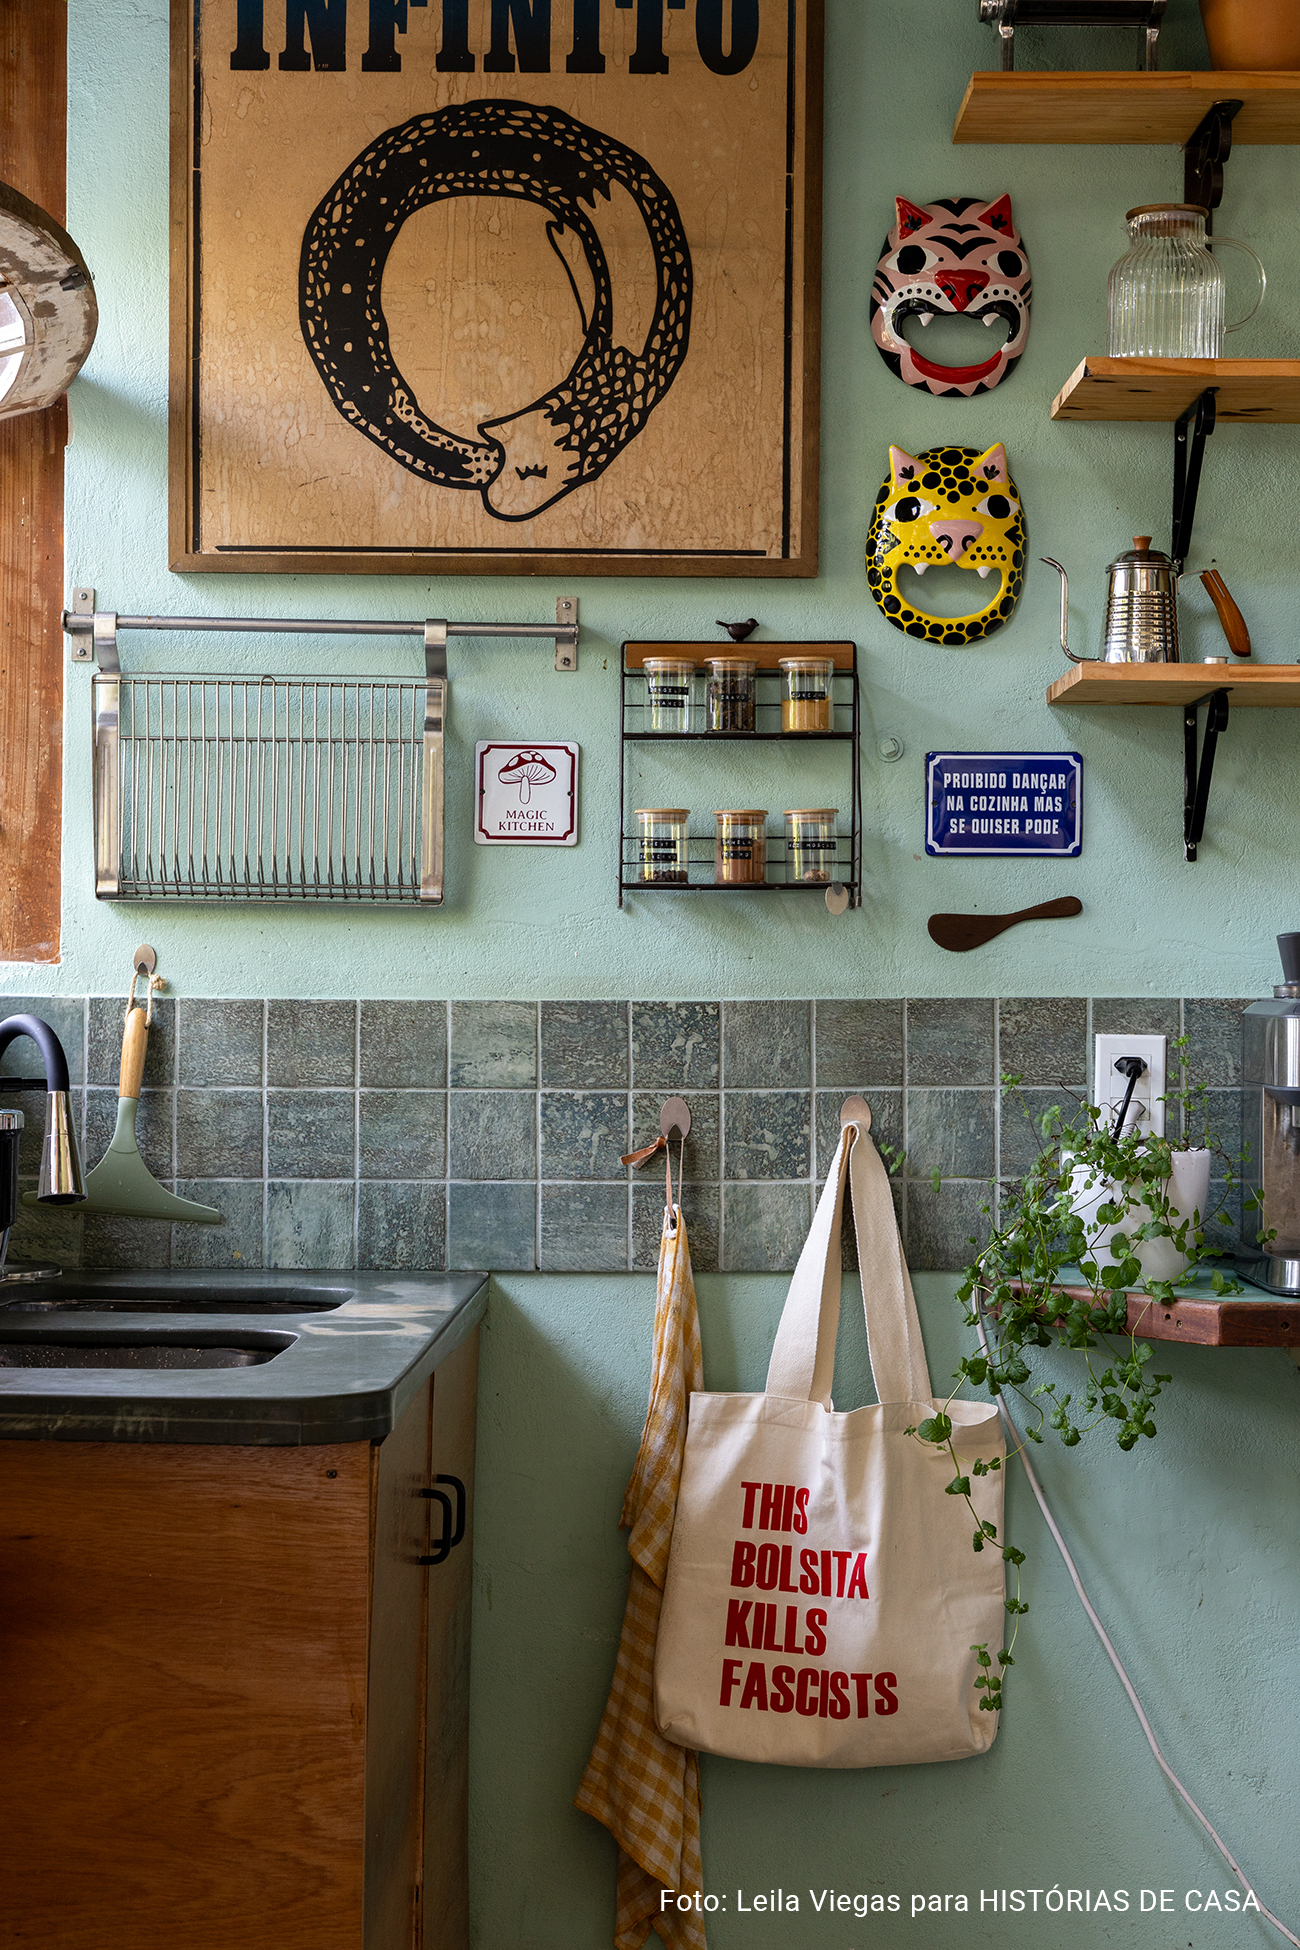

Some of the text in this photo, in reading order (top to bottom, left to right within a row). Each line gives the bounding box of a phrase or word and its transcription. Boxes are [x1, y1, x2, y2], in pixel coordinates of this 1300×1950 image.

[230, 0, 760, 76] INFINITO
[943, 773, 1067, 795] PROIBIDO DANÇAR
[505, 810, 548, 821] MAGIC
[946, 796, 1063, 812] NA COZINHA MAS
[498, 821, 555, 832] KITCHEN
[949, 818, 1059, 835] SE QUISER PODE
[741, 1481, 810, 1535] THIS
[730, 1540, 870, 1600] BOLSITA
[724, 1598, 828, 1657] KILLS
[719, 1658, 899, 1720] FASCISTS
